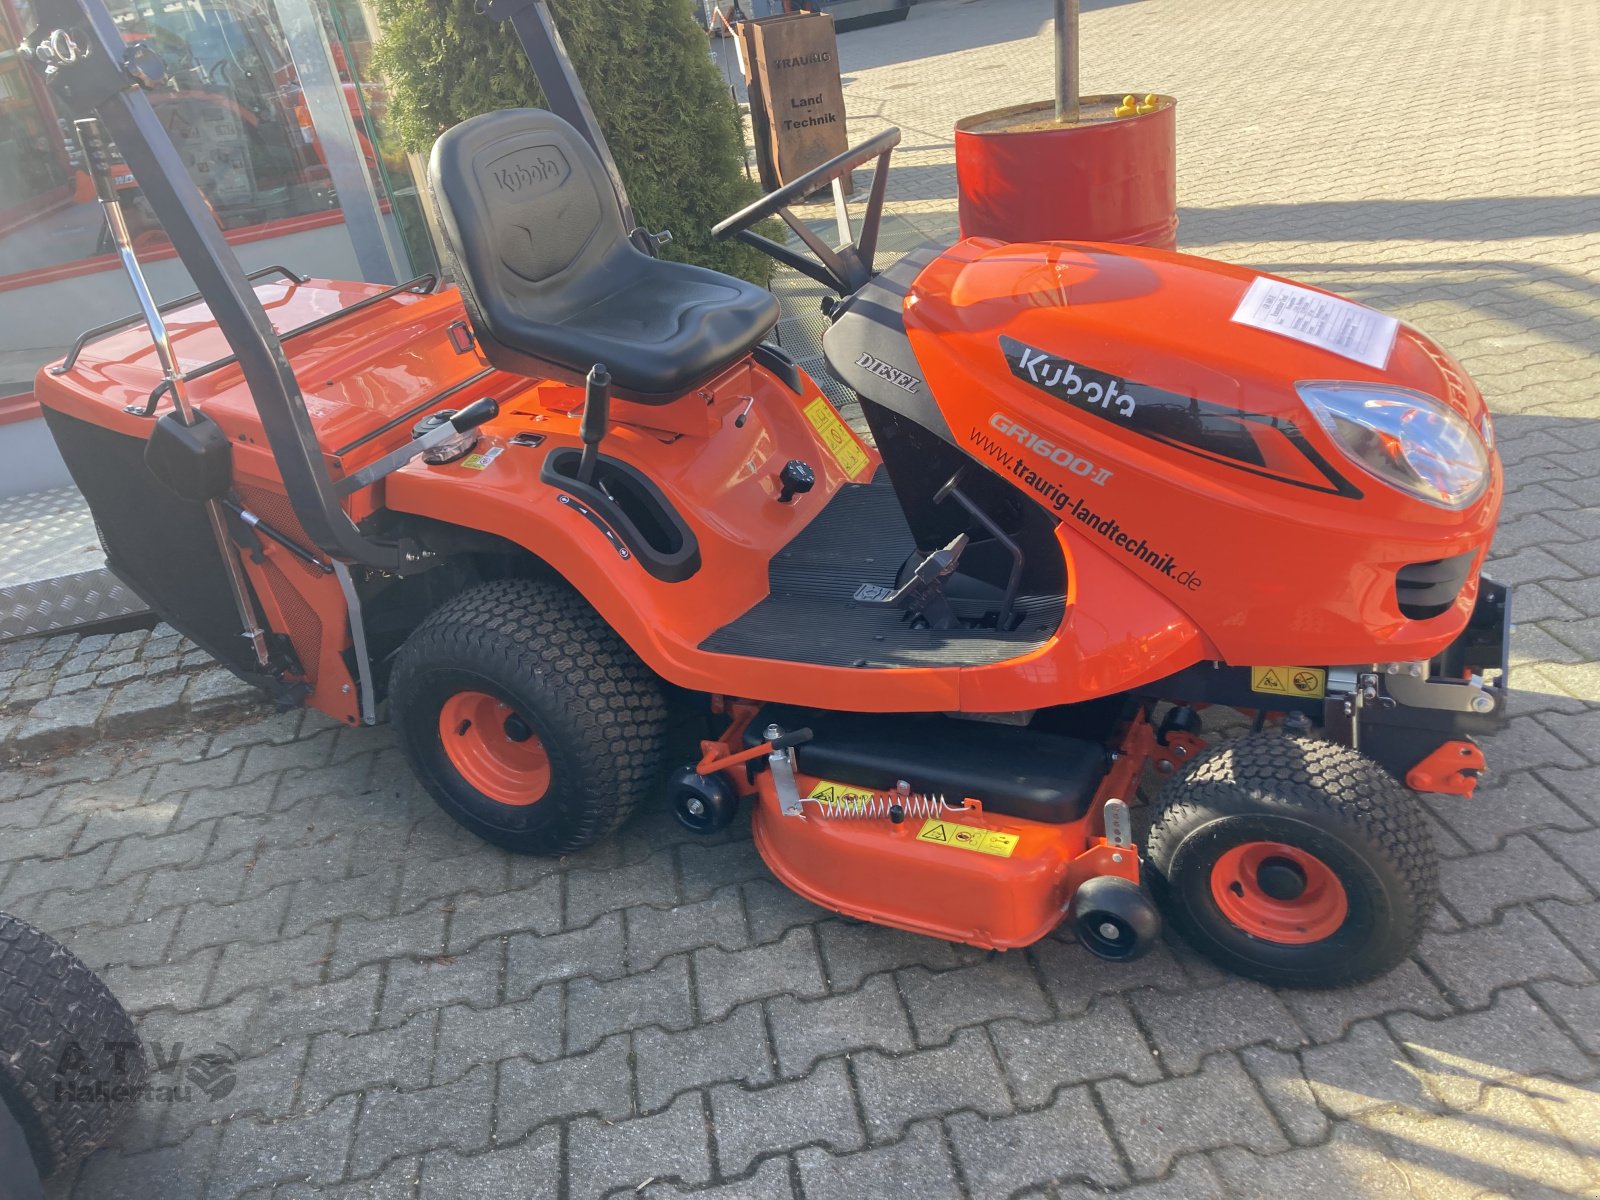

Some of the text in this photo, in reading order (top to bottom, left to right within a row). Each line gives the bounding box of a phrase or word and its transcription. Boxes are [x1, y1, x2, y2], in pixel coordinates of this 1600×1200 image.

[791, 93, 823, 109] Land
[784, 112, 836, 130] Technik
[494, 157, 560, 192] Kubota
[855, 352, 921, 394] DIESEL
[1018, 348, 1136, 418] Kubota
[970, 427, 1202, 591] www.traurig-landtechnik.de
